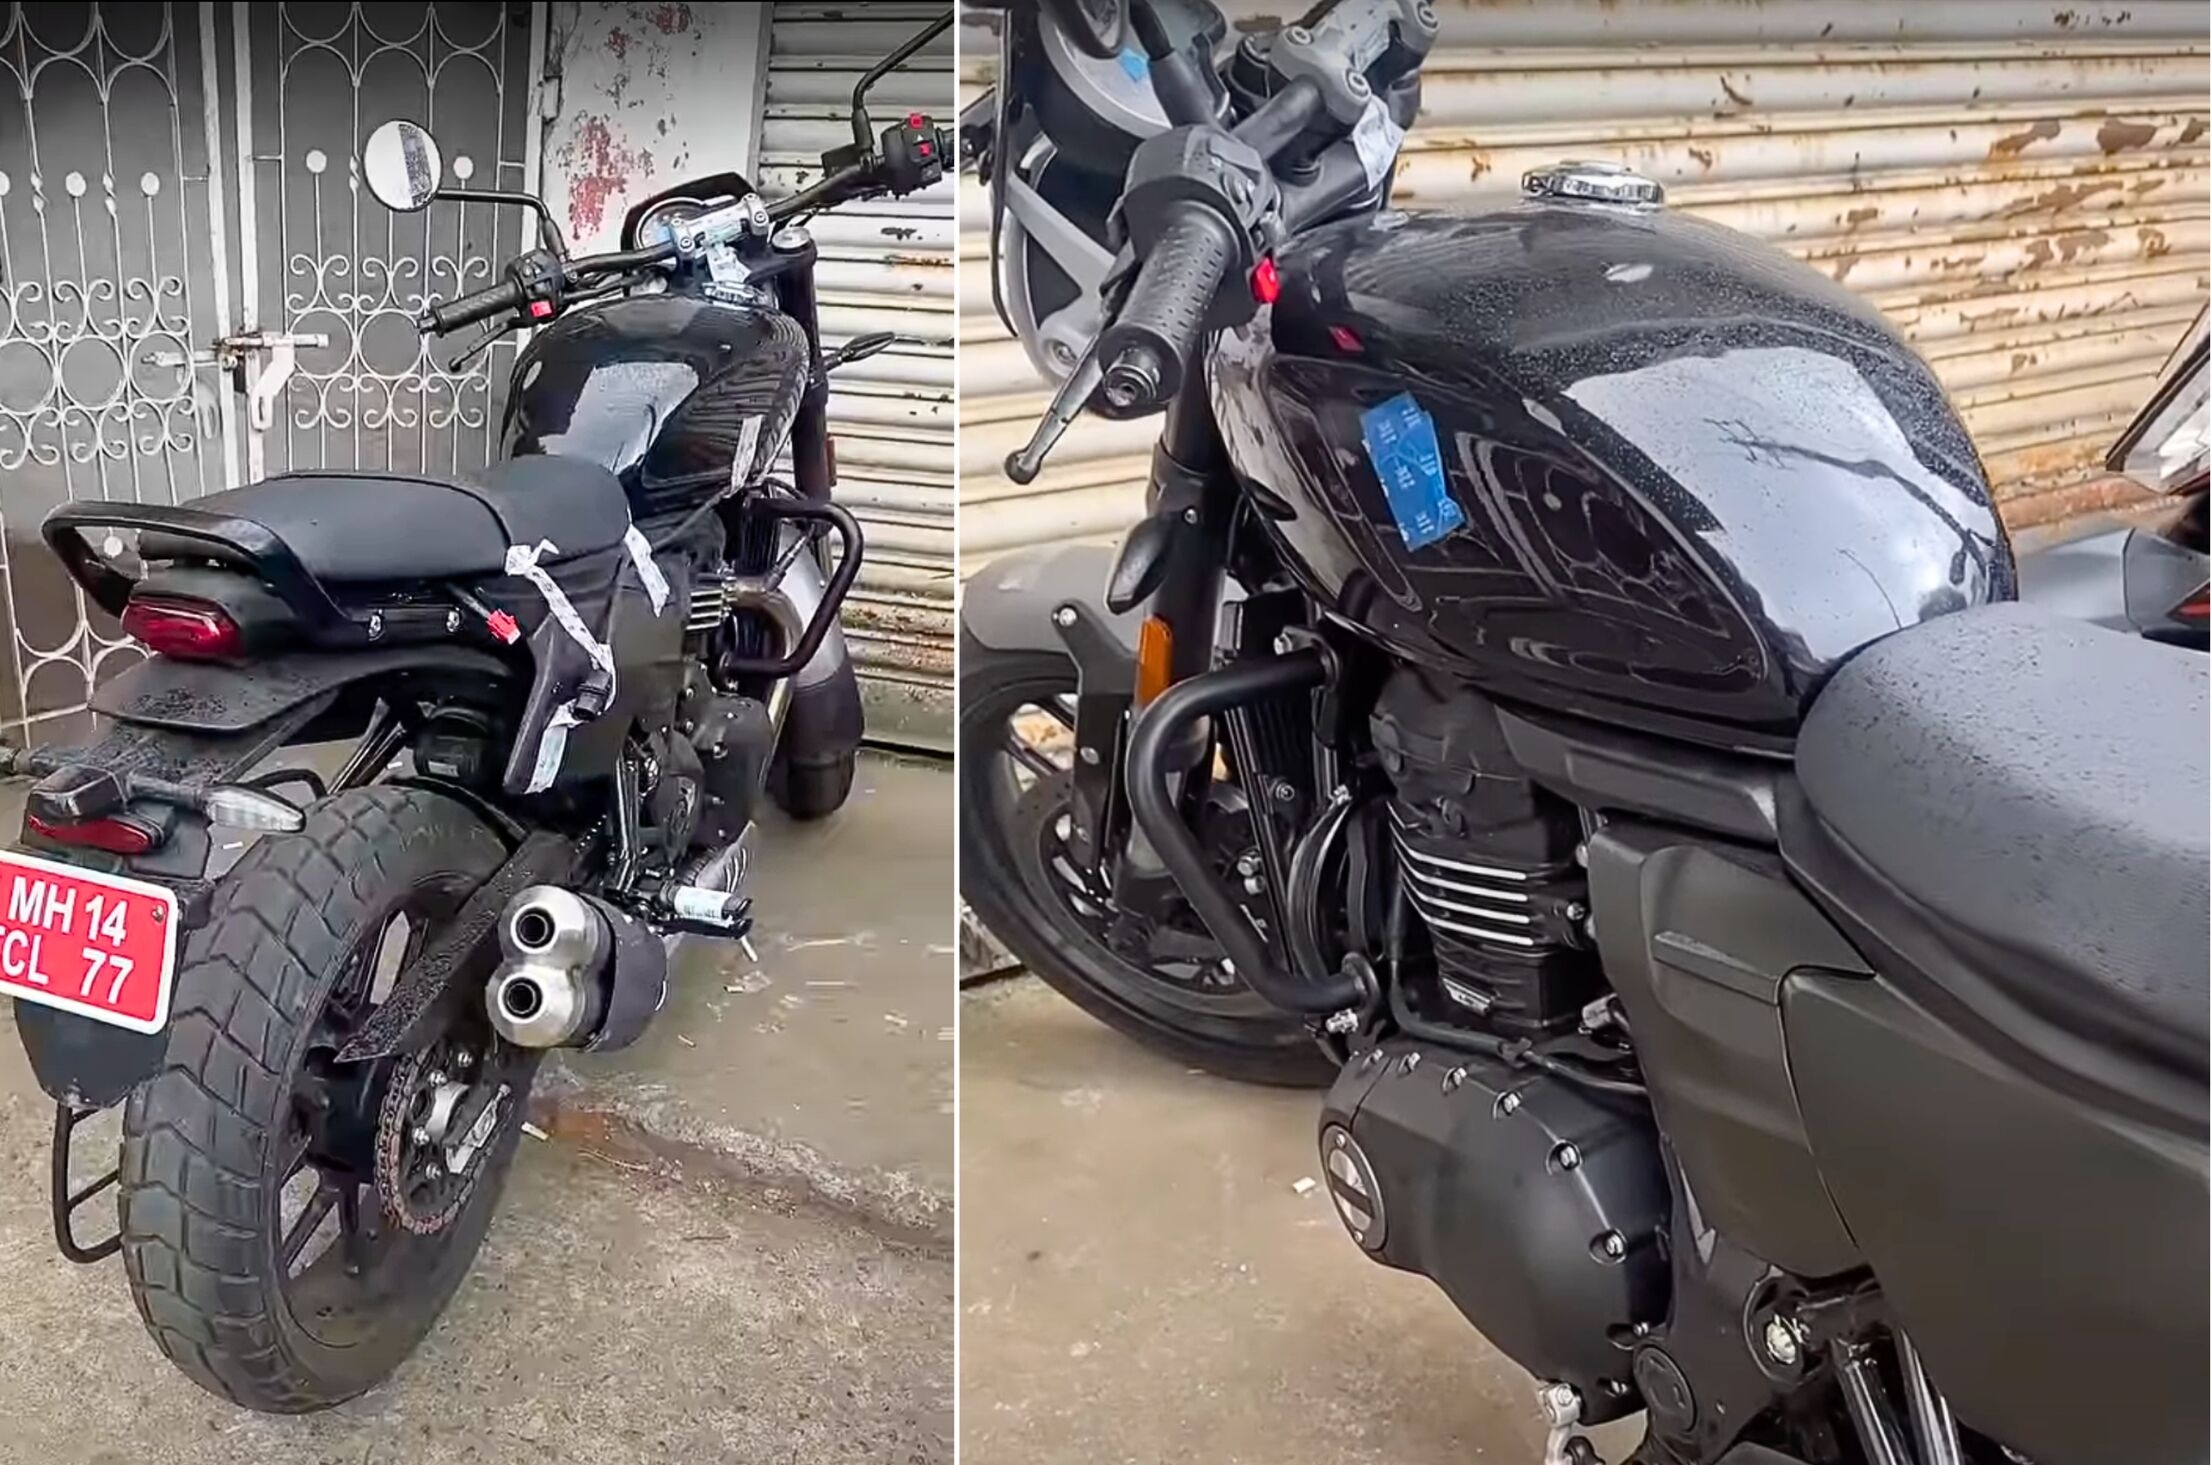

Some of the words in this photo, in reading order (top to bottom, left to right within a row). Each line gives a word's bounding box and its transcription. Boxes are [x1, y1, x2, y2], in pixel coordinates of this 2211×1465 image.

[9, 877, 76, 933] MH
[86, 896, 127, 947] 14
[0, 925, 49, 985] CL
[81, 948, 134, 1004] 77
